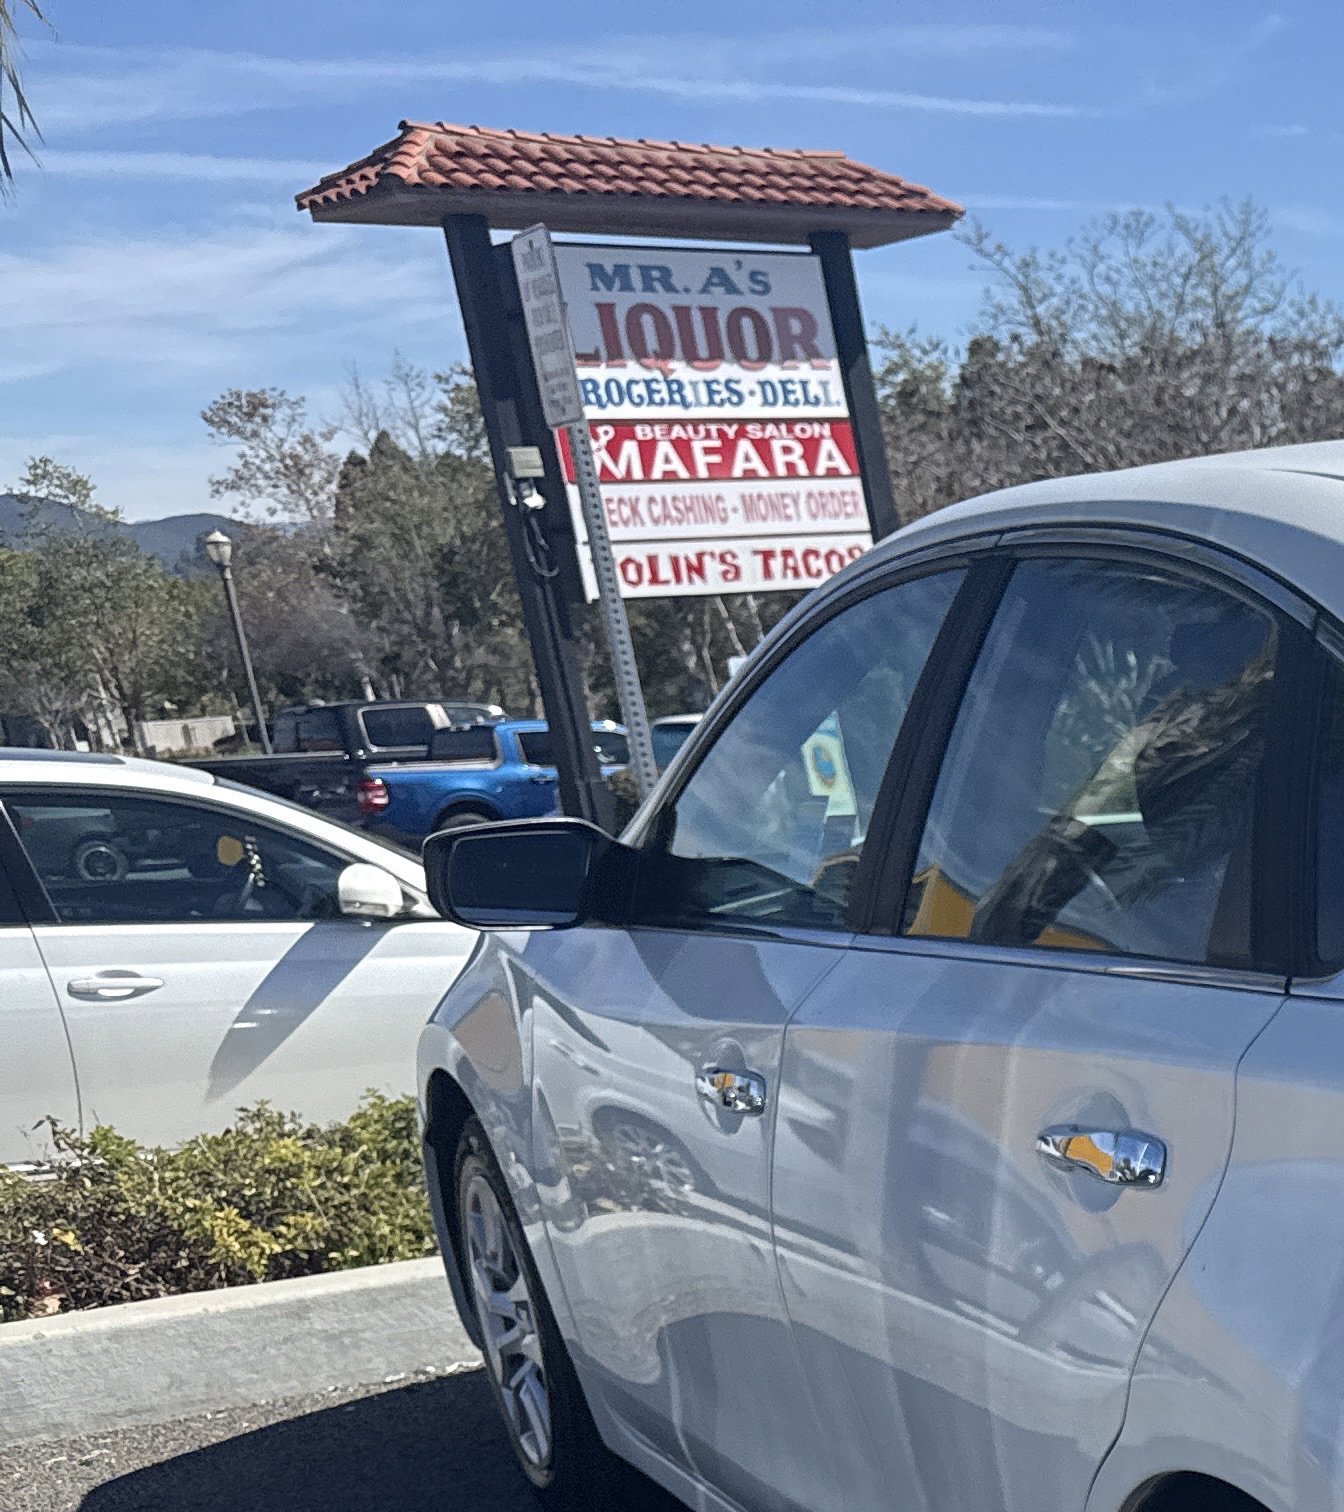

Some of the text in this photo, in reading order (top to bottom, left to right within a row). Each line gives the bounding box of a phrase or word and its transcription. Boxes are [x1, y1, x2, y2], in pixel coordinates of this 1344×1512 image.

[586, 262, 691, 293] MR.
[575, 303, 832, 378] IQUOR
[578, 378, 745, 409] ROCERIES
[634, 423, 832, 440] BEAUTY SALON
[592, 438, 852, 481] MAFARA
[605, 489, 864, 528] ECK CASHING MONEY ORDER
[619, 551, 743, 588] OLIN'S
